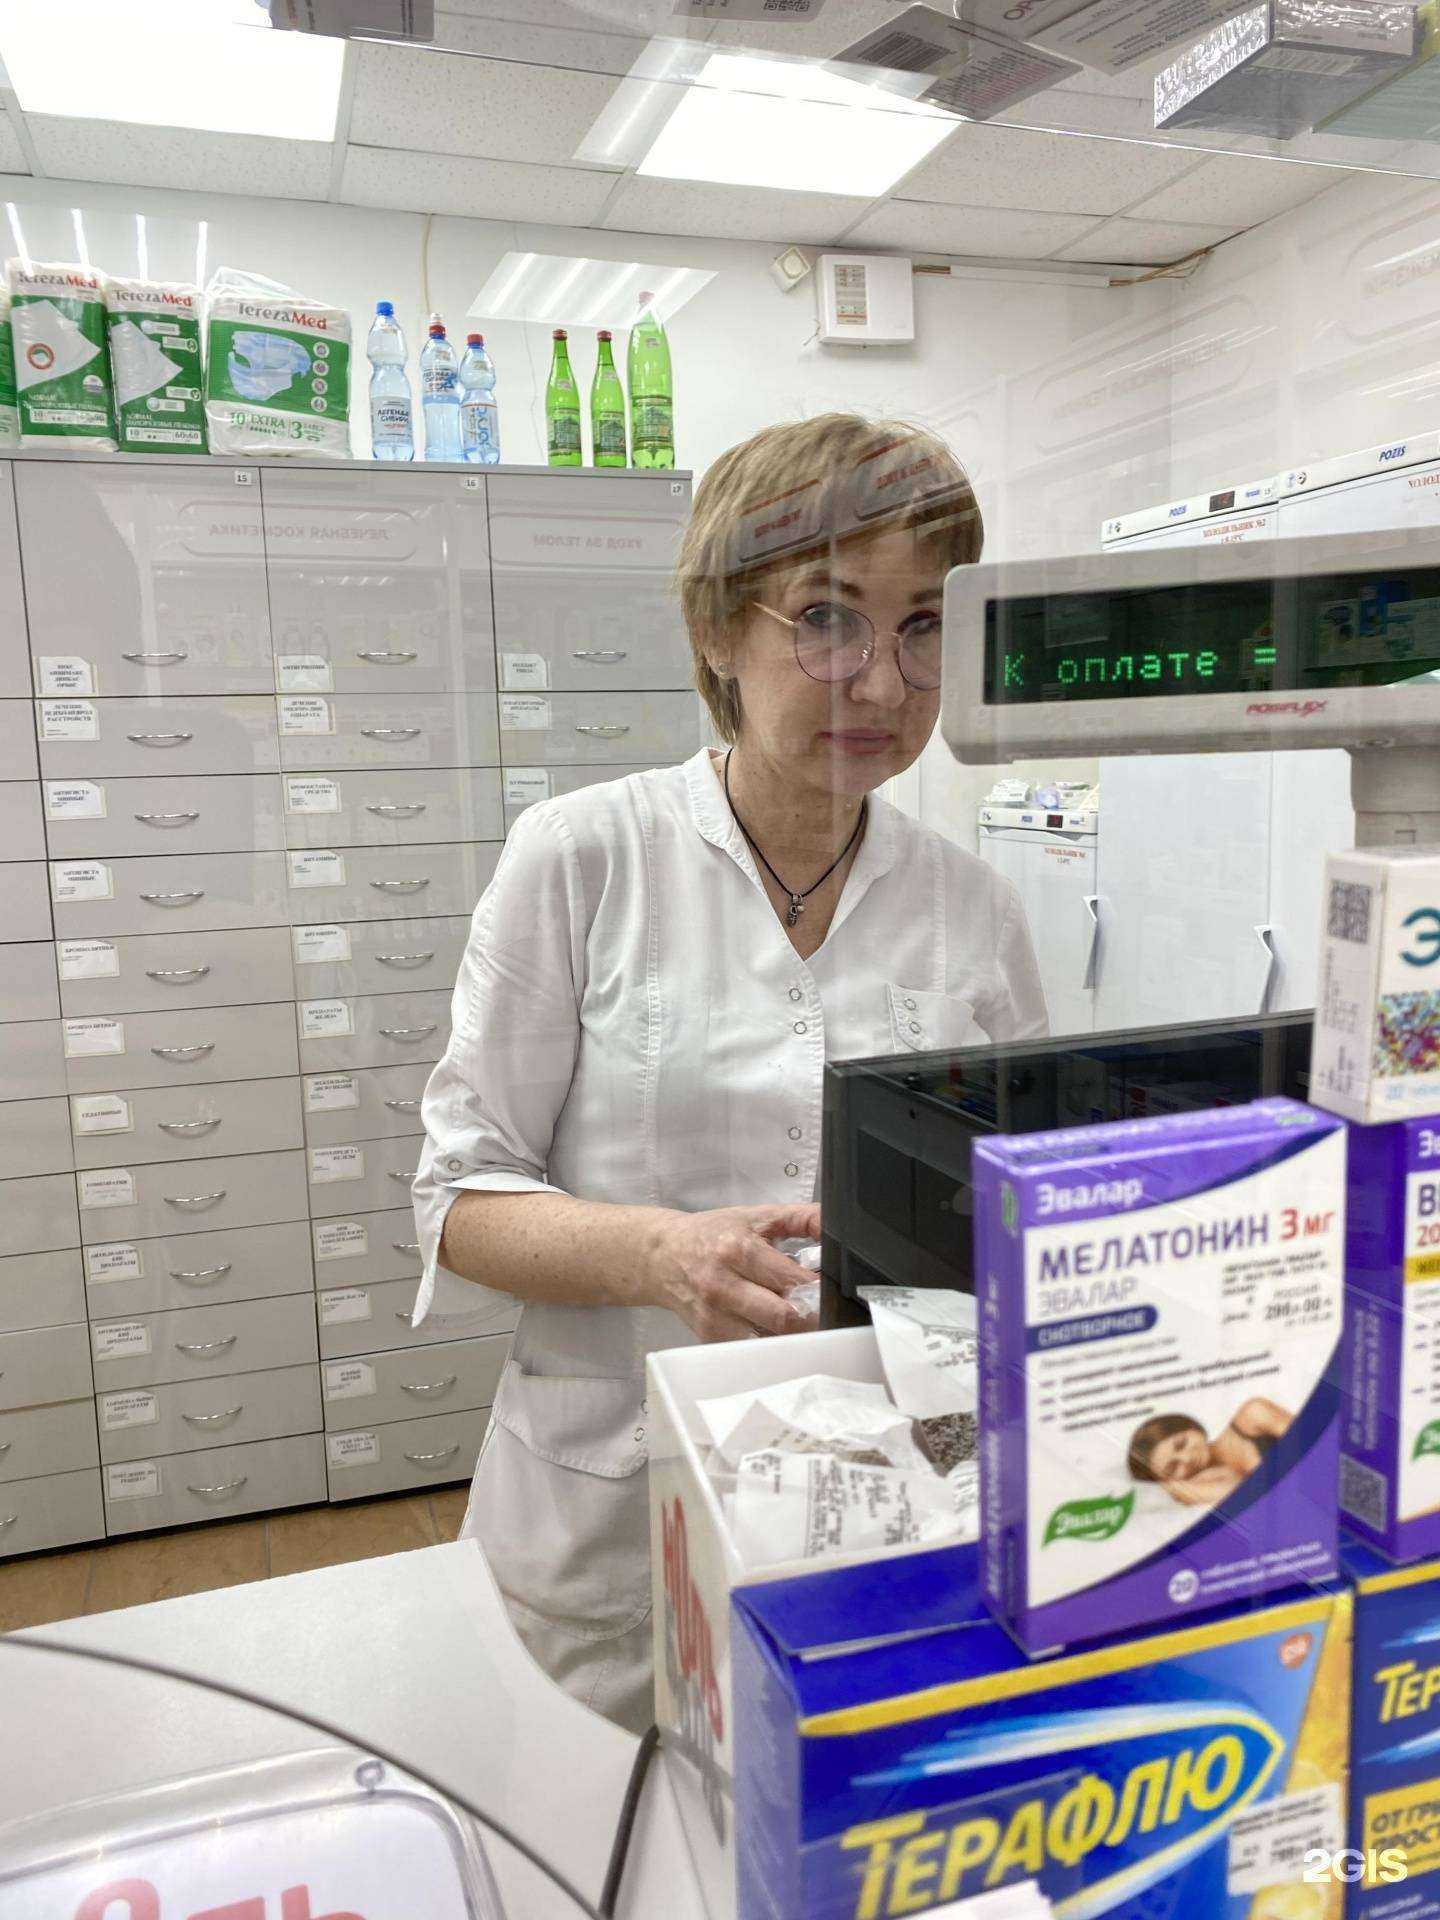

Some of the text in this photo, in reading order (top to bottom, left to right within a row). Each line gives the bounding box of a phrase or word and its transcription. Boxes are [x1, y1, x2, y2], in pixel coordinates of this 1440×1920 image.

[114, 289, 193, 308] TerezaMed
[237, 302, 328, 331] TerezaMed
[250, 414, 286, 429] EXTRA
[290, 421, 304, 439] 3
[1378, 445, 1407, 463] POZIS
[236, 474, 248, 483] 15
[1003, 653, 1026, 688] К
[1058, 650, 1219, 685] оплате
[1035, 1177, 1144, 1216] Эвалар
[1038, 1213, 1270, 1283] МЕЛАТОНИН
[1279, 1208, 1299, 1241] 3
[1036, 1276, 1139, 1317] ЭВАЛАР
[841, 1735, 1244, 1920] ТЕРАФЛЮ
